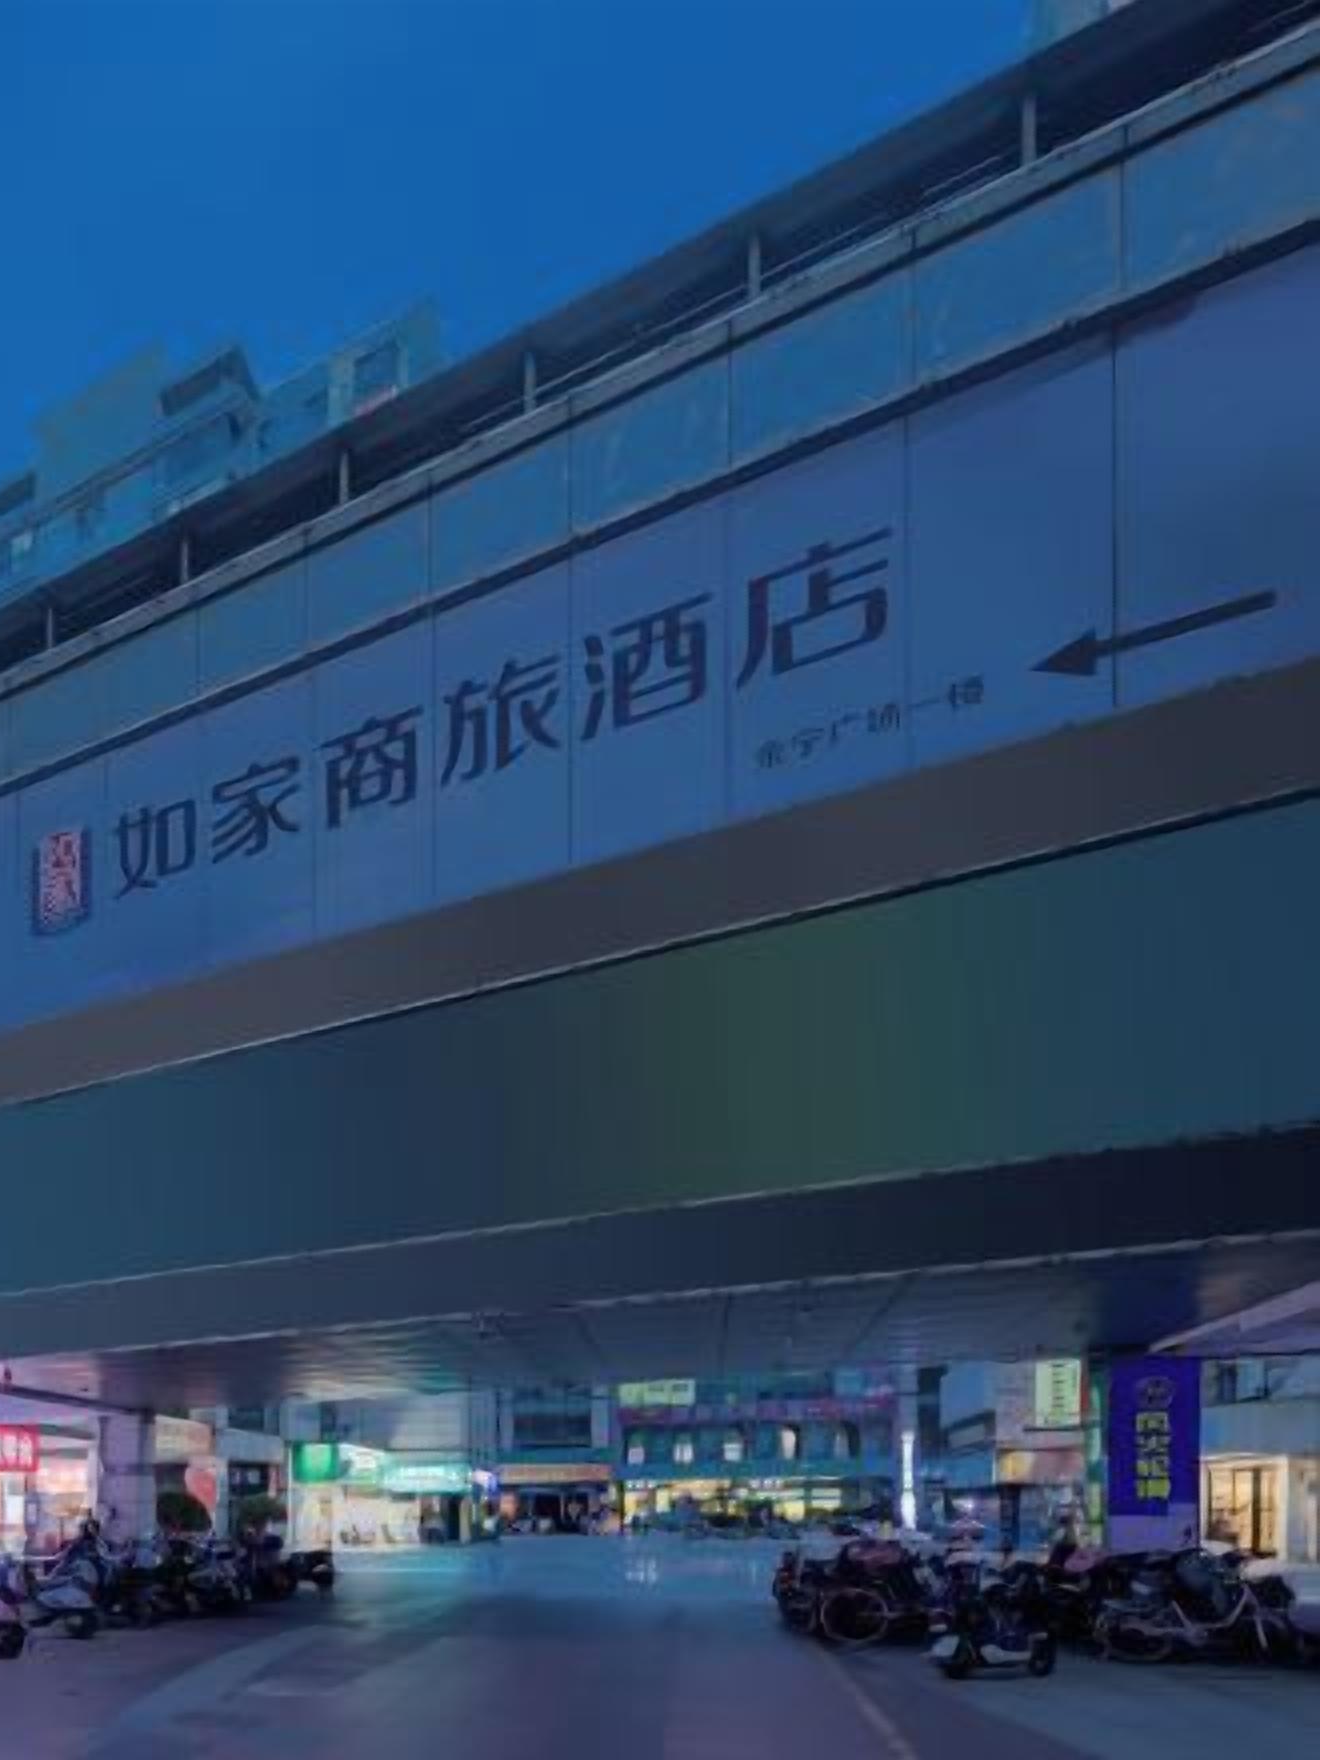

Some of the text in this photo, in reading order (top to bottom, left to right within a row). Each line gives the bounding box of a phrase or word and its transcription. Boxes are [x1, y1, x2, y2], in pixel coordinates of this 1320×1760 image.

[116, 527, 894, 900] 如家商旅酒店
